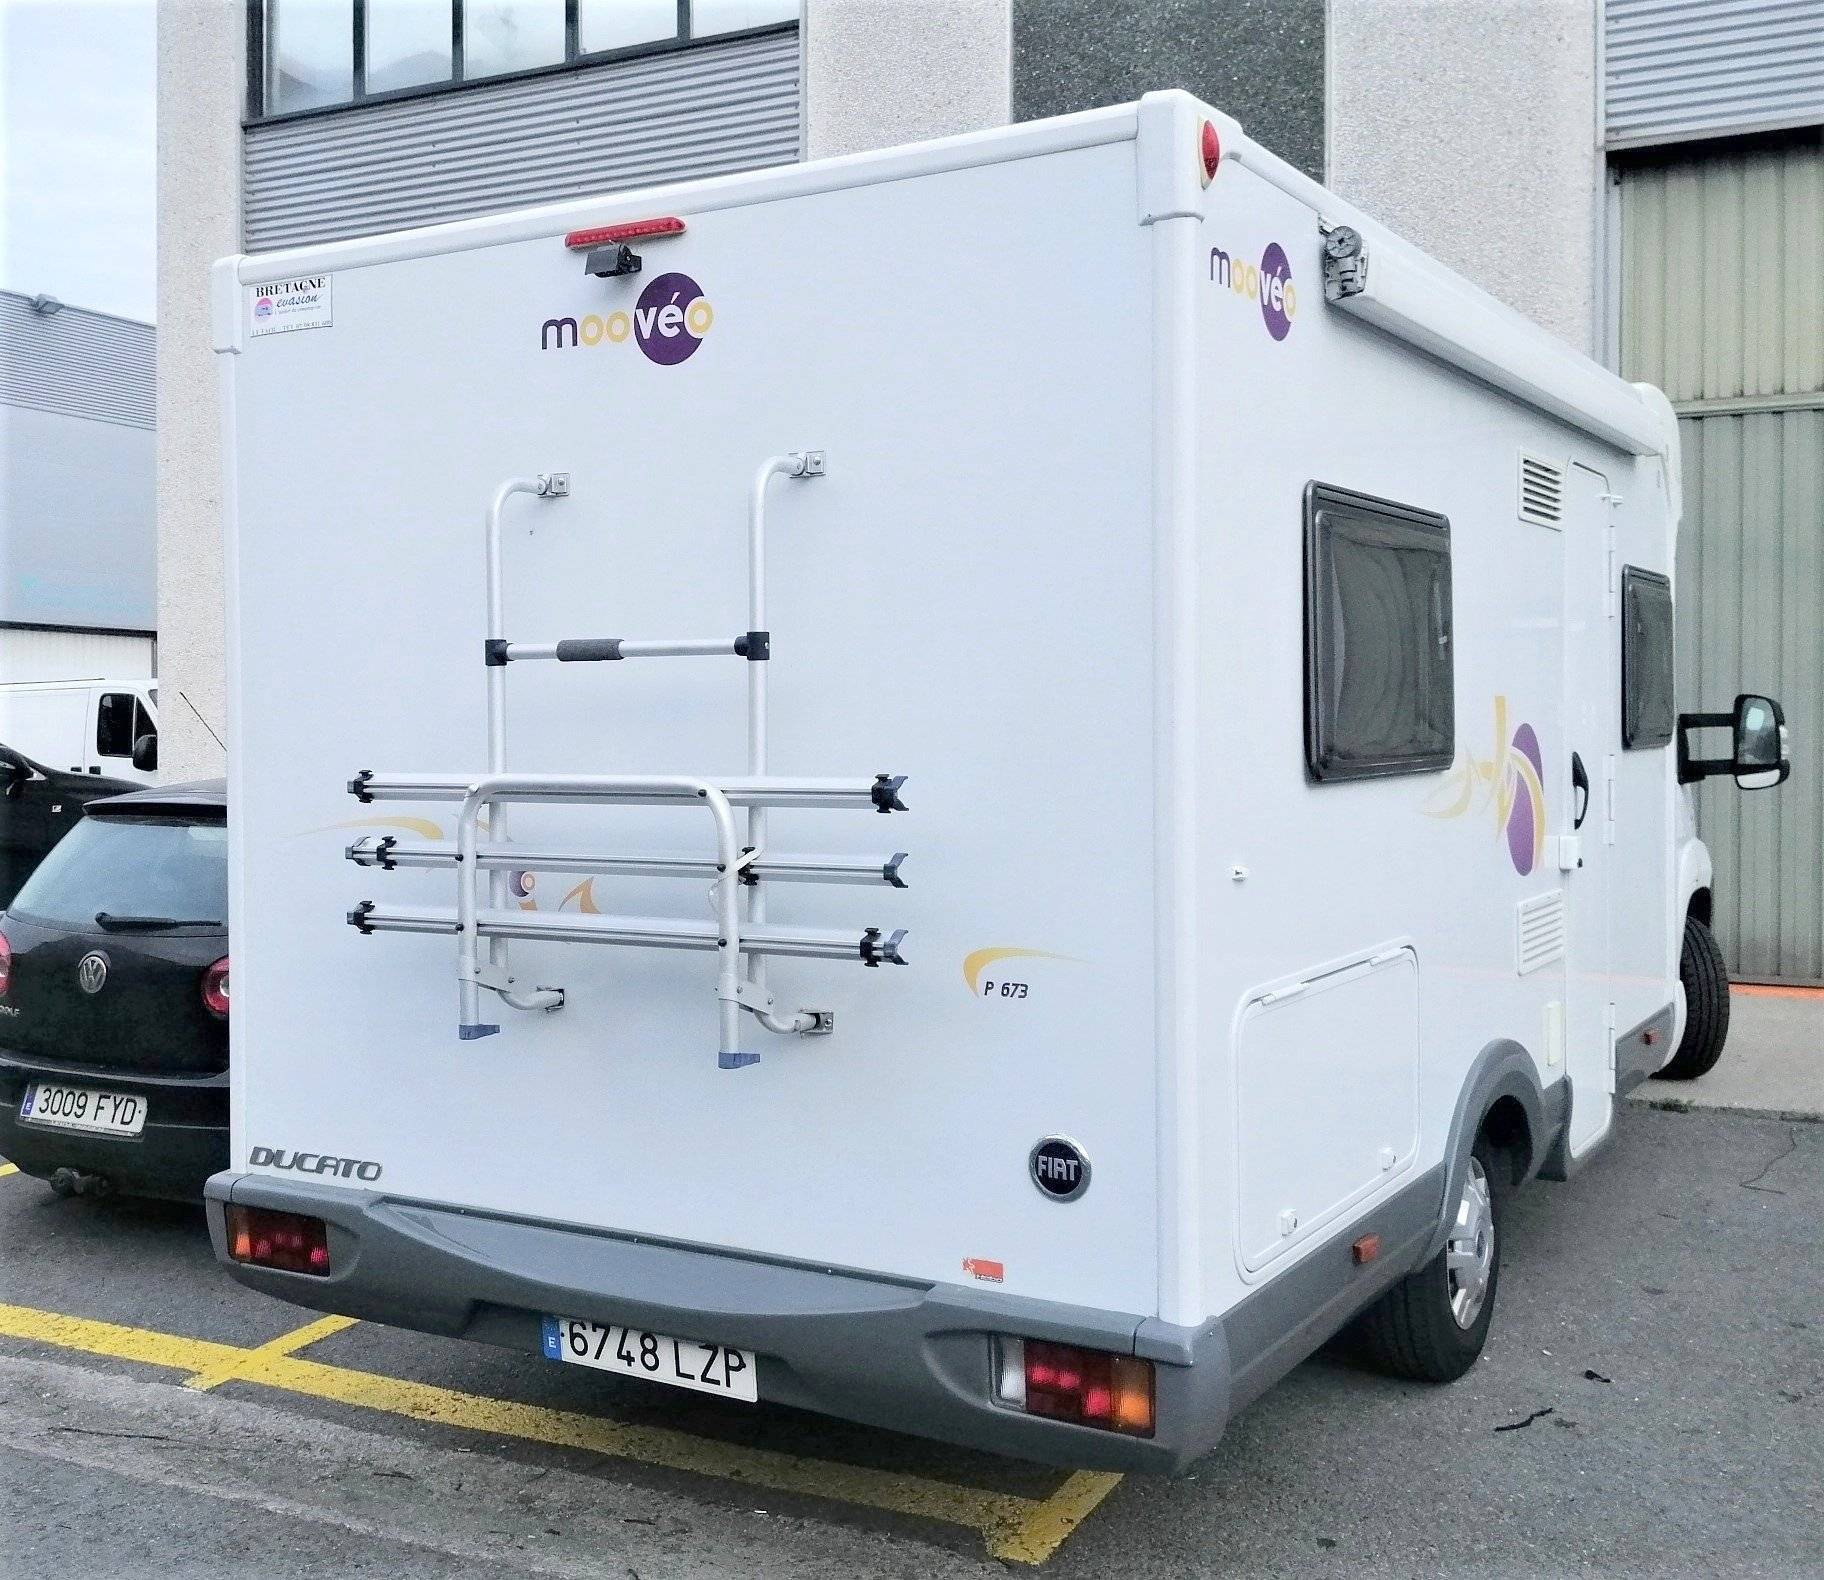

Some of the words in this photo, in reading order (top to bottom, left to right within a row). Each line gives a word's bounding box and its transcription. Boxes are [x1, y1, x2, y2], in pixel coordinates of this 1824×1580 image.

[256, 278, 326, 298] BRETAGNE
[1210, 247, 1297, 318] moovéo
[276, 294, 319, 308] evasion
[541, 291, 714, 351] moovéo
[984, 981, 995, 996] P
[1001, 982, 1029, 999] 673
[39, 1088, 88, 1119] 3009
[94, 1094, 138, 1126] FYD
[250, 1146, 383, 1182] DUCATO
[1037, 1155, 1079, 1181] FIAT
[548, 1336, 557, 1349] E
[568, 1320, 660, 1372] 6748
[673, 1339, 748, 1388] LZP
